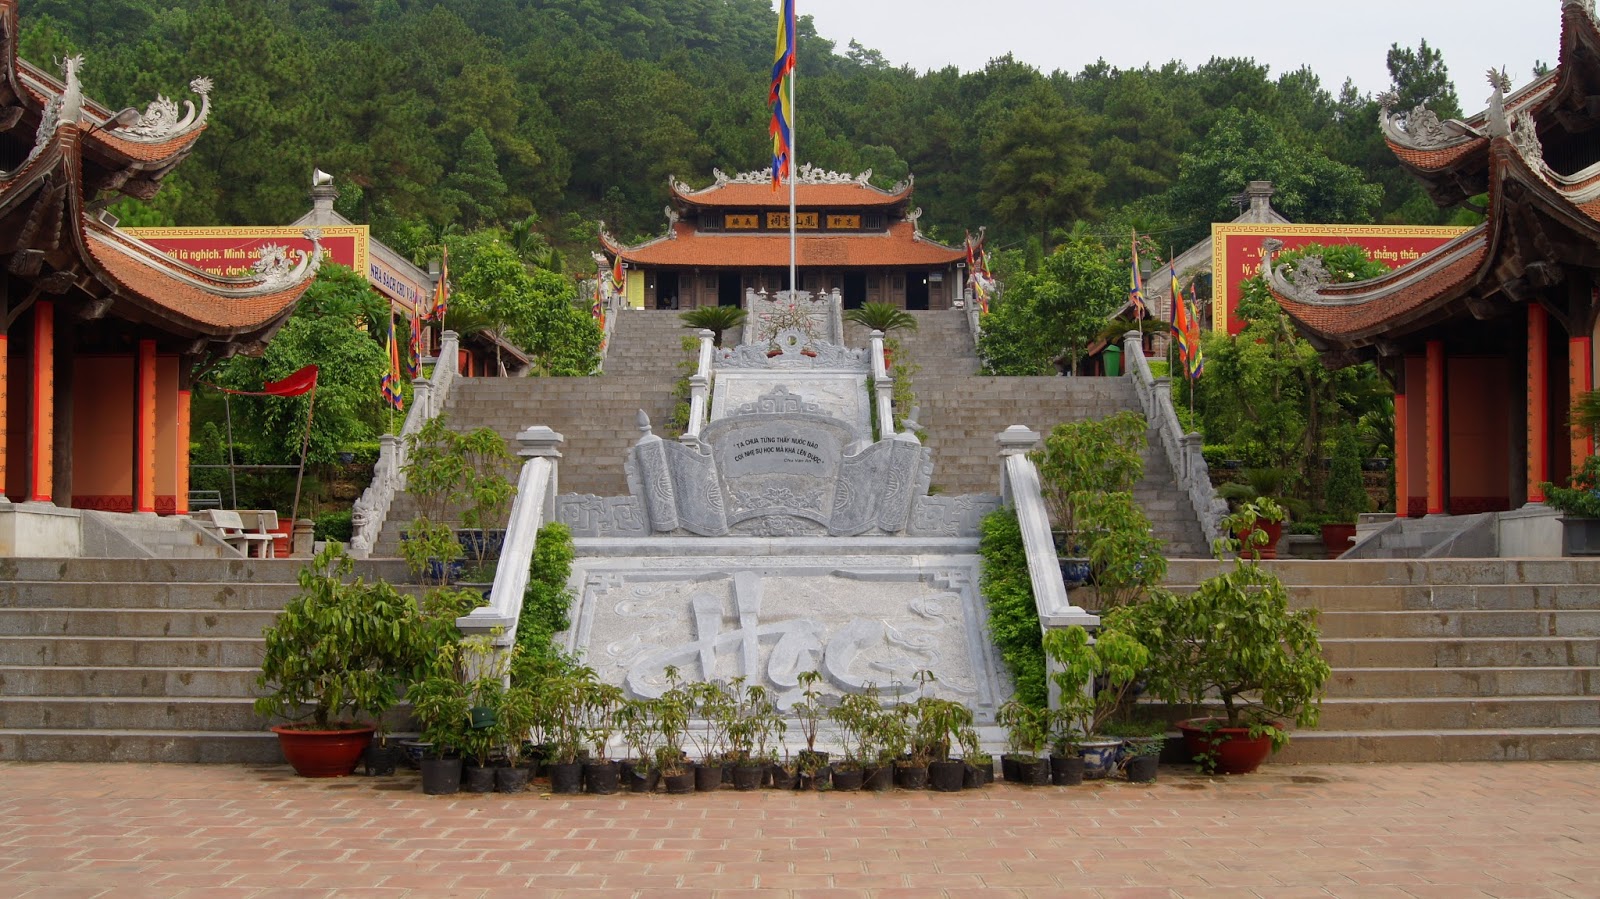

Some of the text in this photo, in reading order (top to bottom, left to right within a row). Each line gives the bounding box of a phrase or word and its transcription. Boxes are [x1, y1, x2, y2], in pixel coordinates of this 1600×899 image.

[179, 249, 188, 260] là
[190, 249, 221, 262] nghịch.
[224, 248, 245, 259] Mình
[1373, 245, 1398, 262] thẳng
[1400, 247, 1419, 260] thắn
[1242, 263, 1252, 276] lý,
